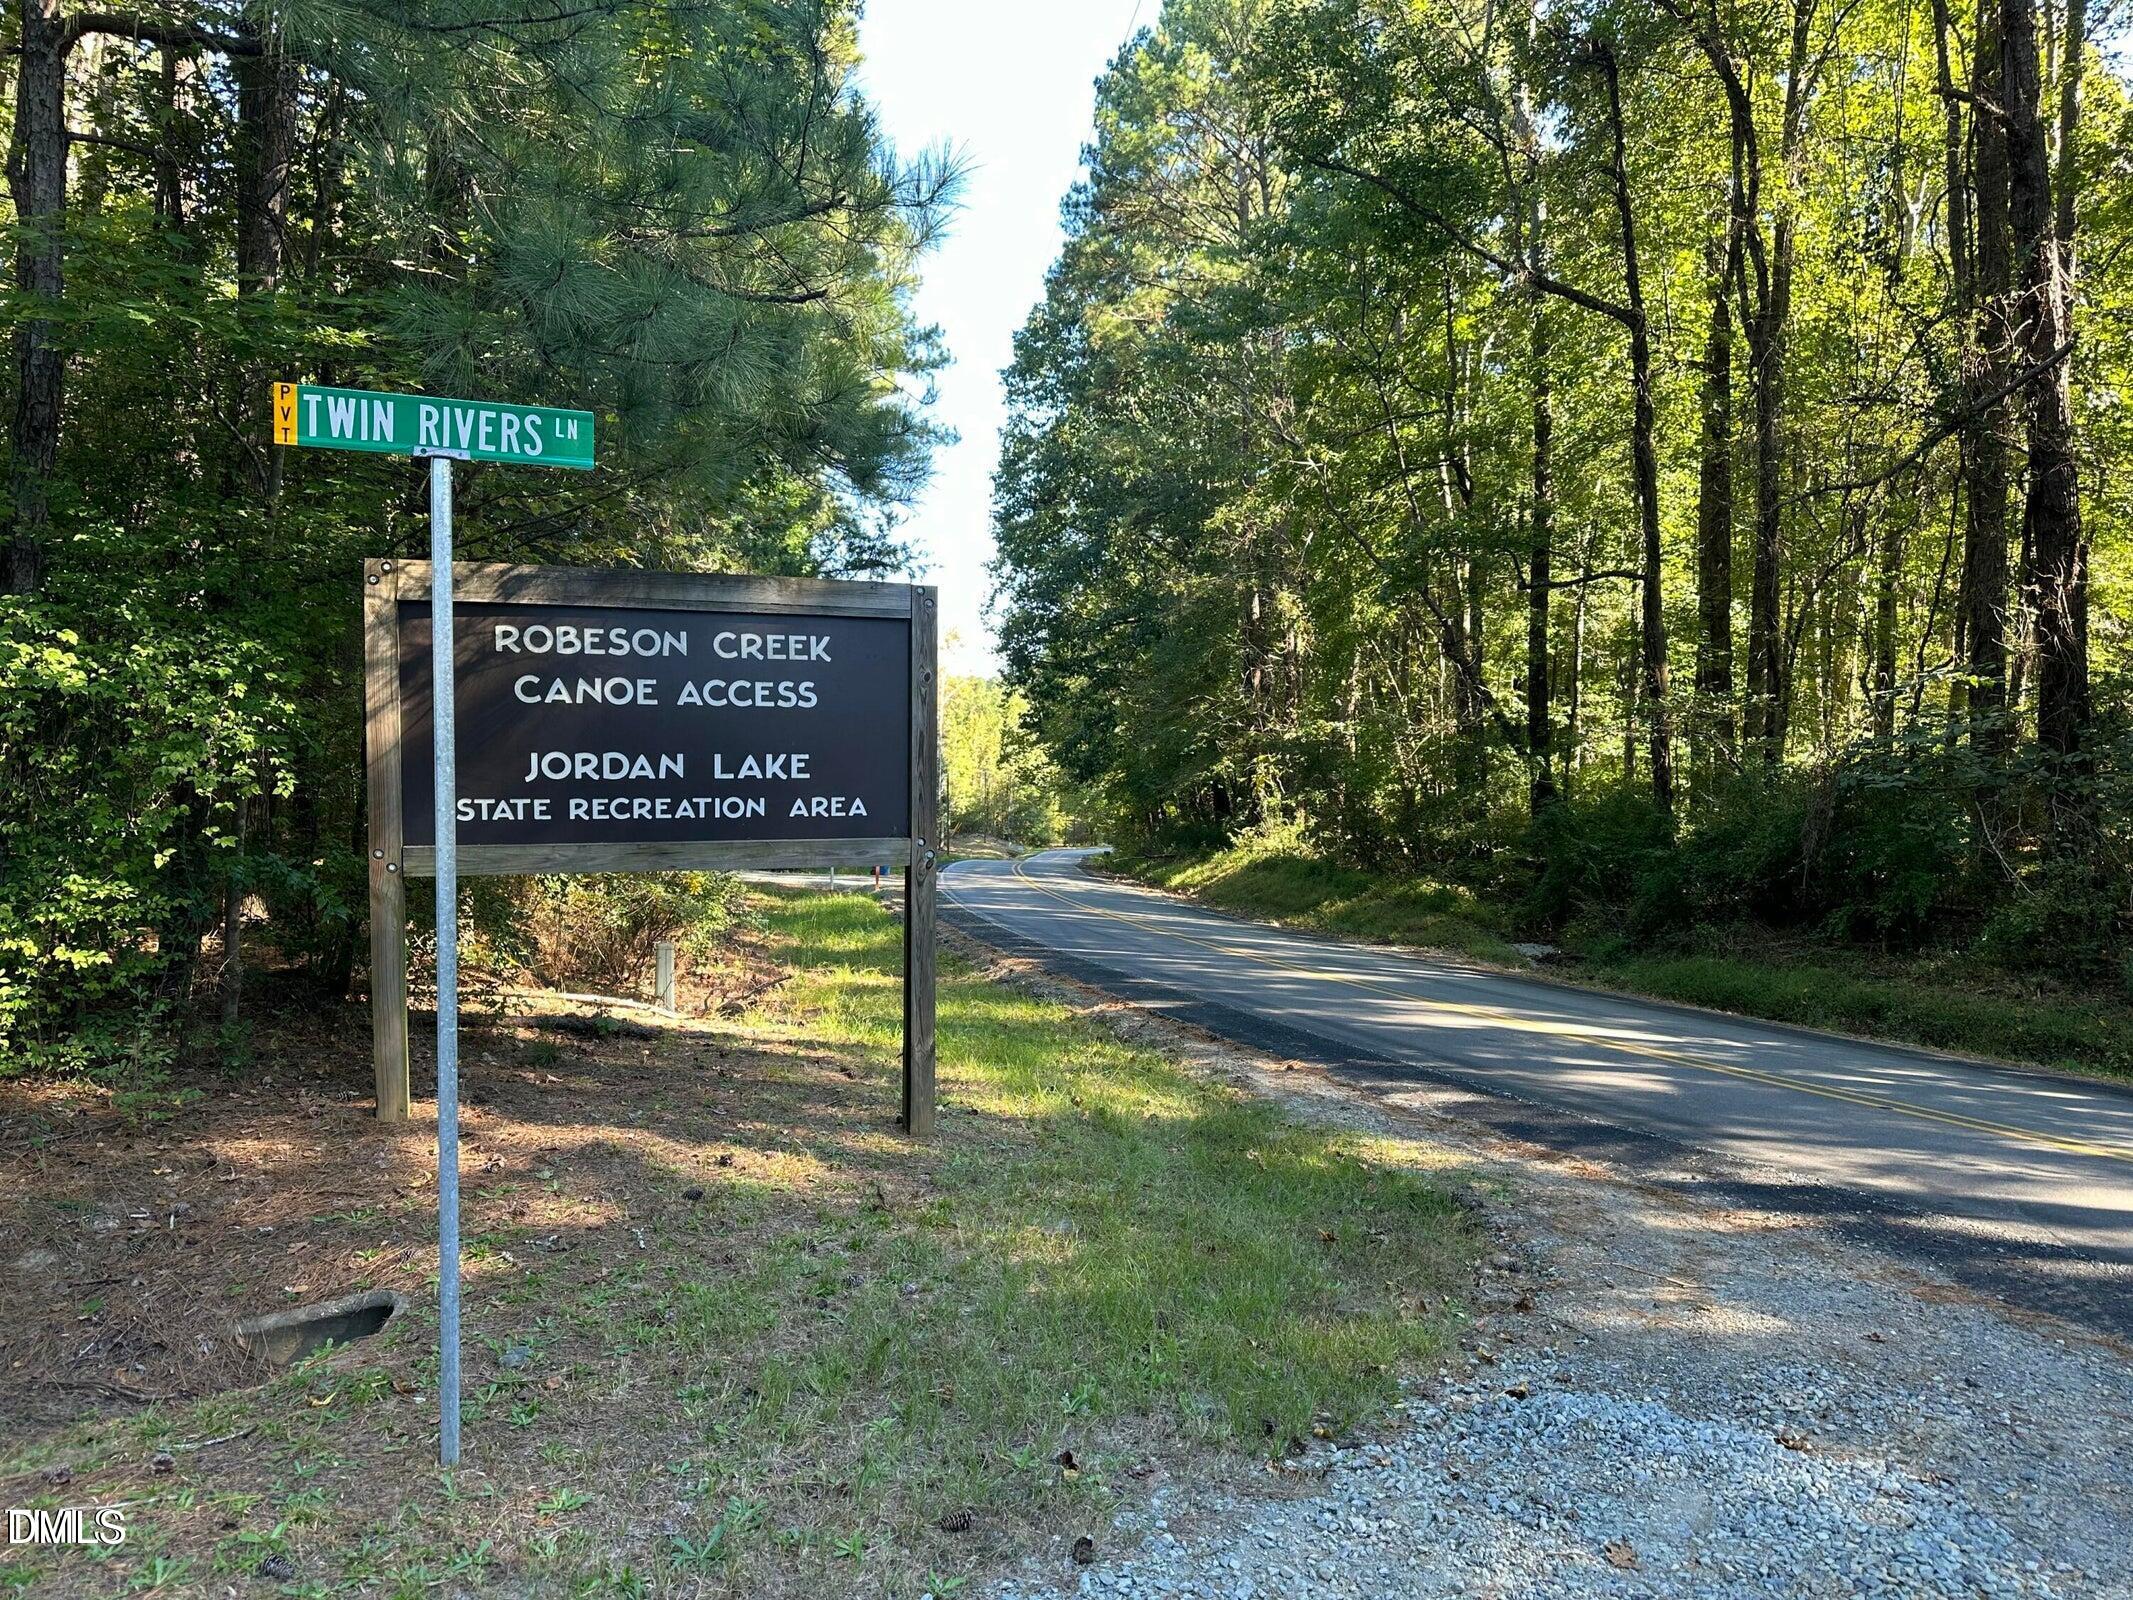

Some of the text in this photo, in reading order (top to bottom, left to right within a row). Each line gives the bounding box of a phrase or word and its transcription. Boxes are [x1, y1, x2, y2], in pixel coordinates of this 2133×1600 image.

[279, 384, 291, 443] PVT
[303, 394, 578, 456] TWIN RIVERS LN
[495, 625, 832, 662] ROBESON CREEK
[514, 675, 818, 708] CANOE ACCESS
[525, 751, 811, 783] JORDAN LAKE
[456, 796, 868, 821] STATE RECREATION AREA
